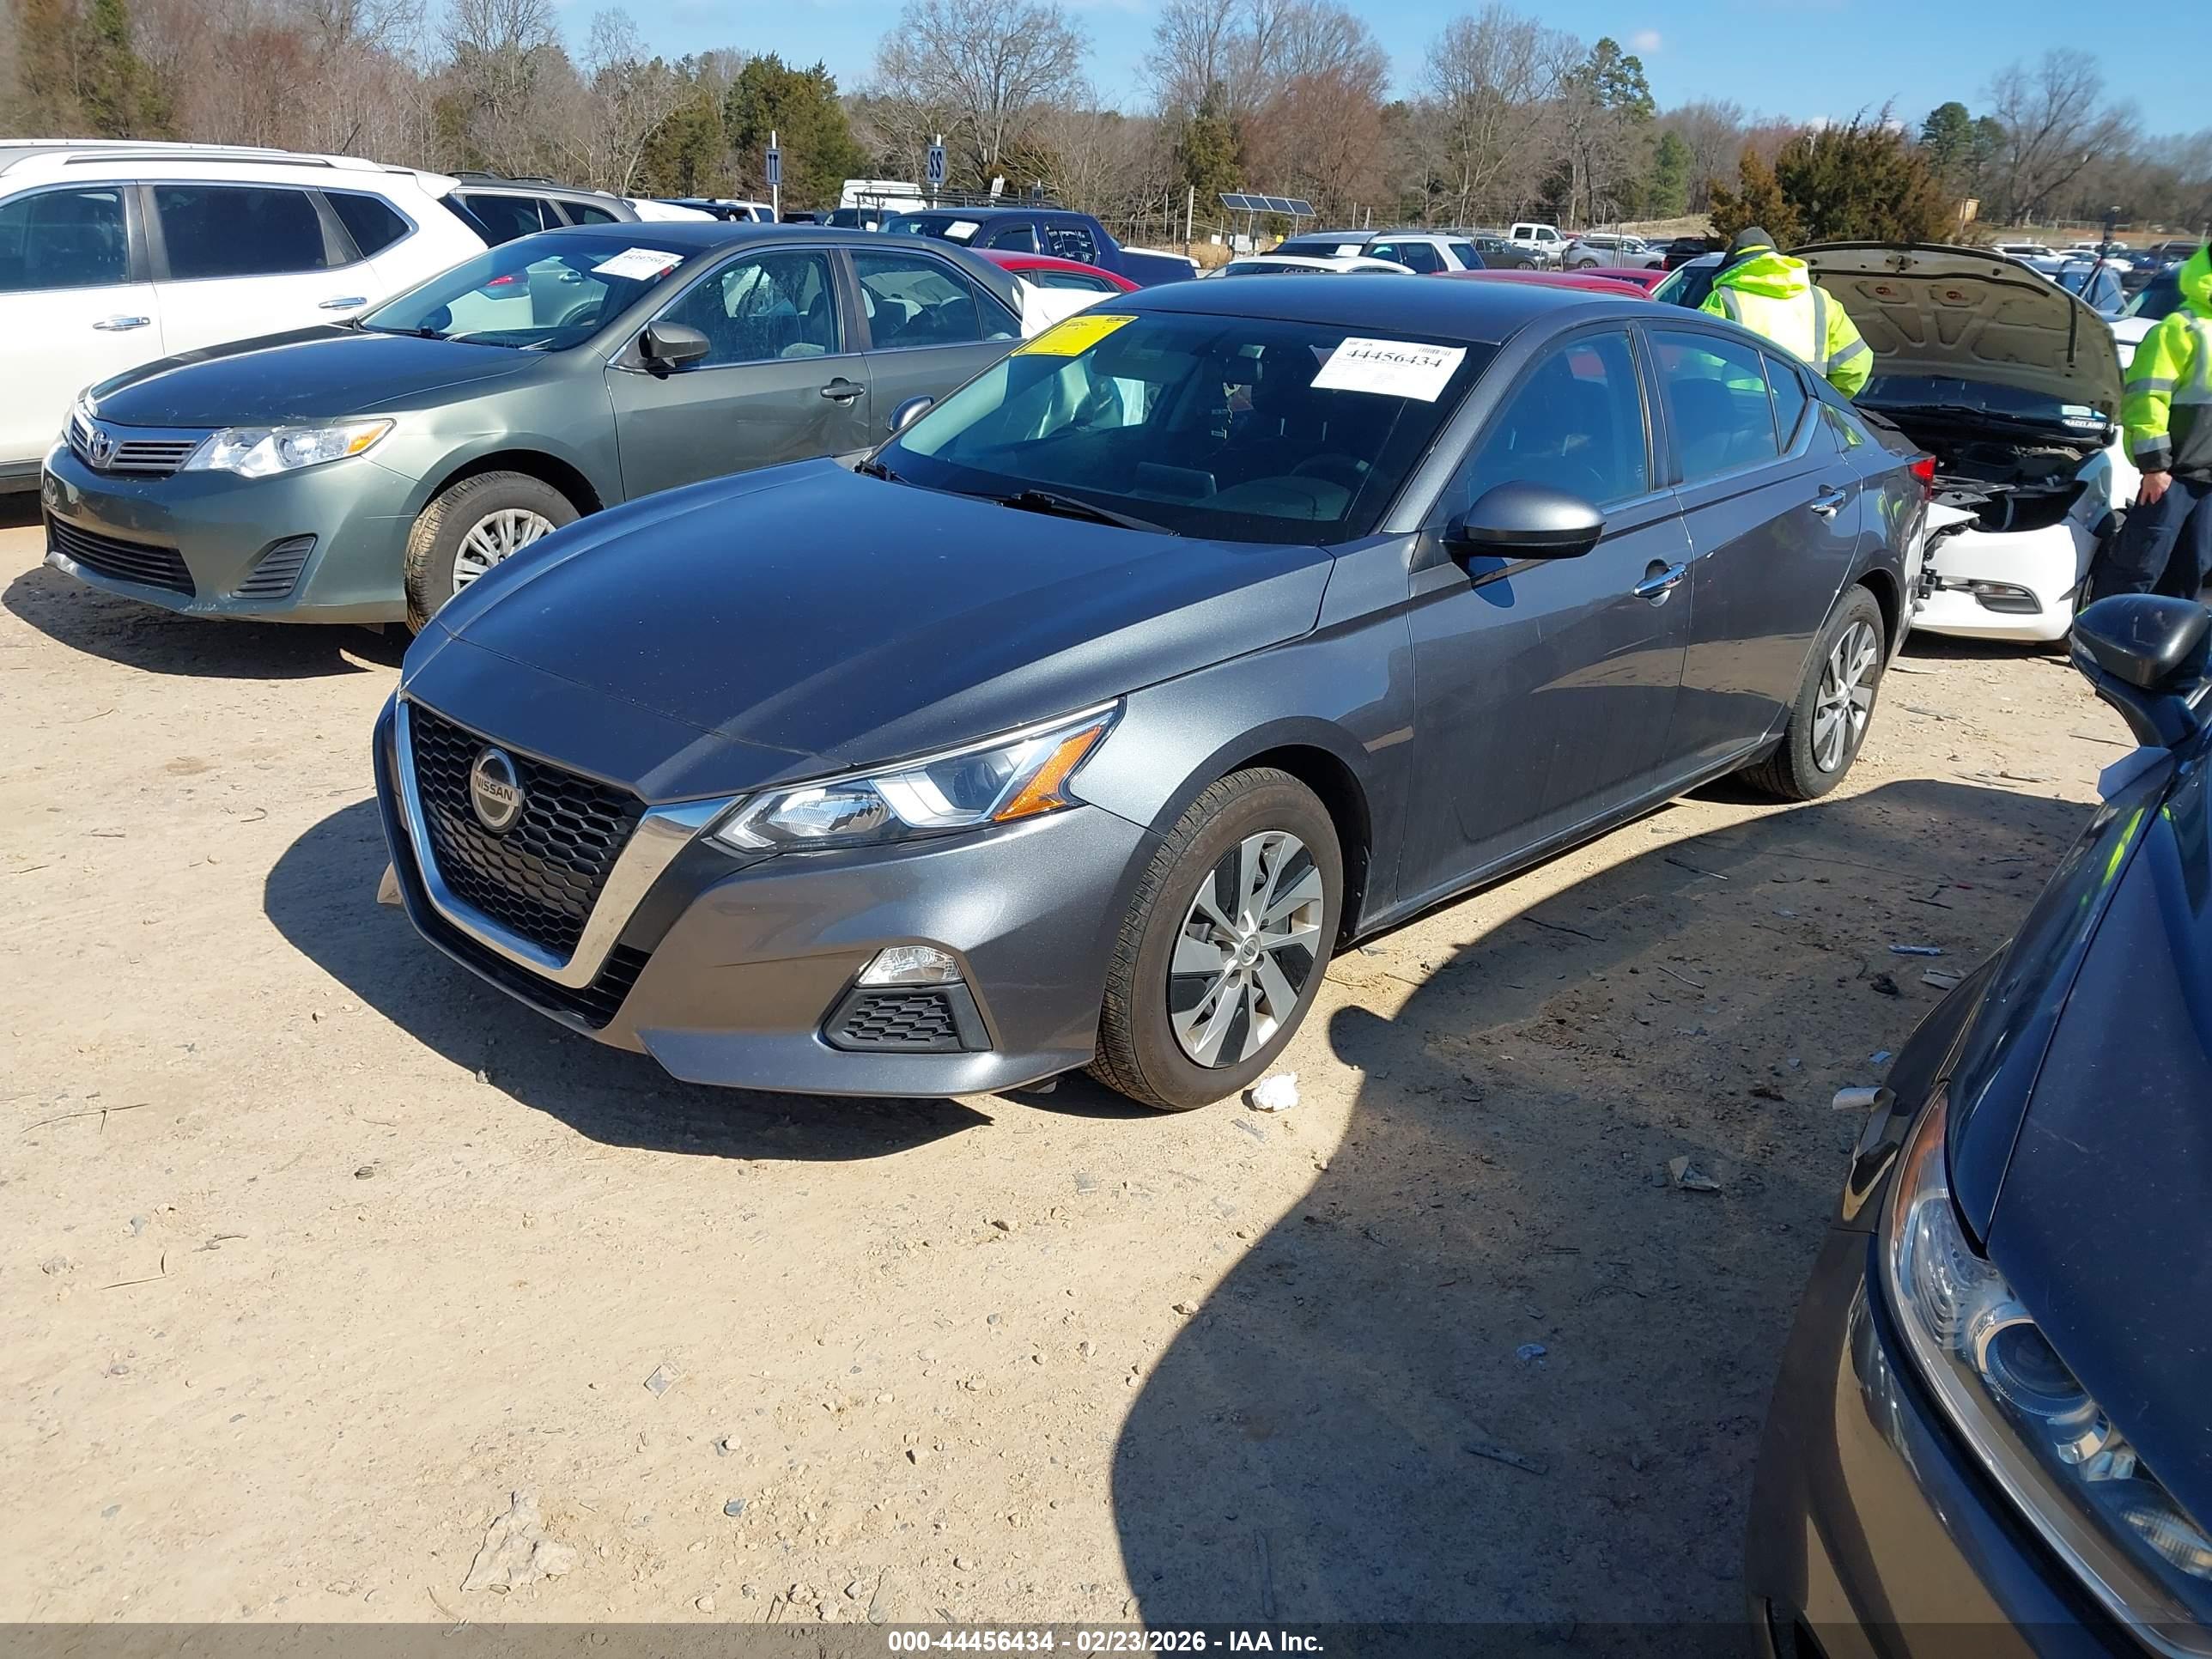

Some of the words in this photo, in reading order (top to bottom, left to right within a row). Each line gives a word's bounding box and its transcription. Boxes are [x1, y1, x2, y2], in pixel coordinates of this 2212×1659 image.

[768, 154, 779, 180] TT
[929, 150, 943, 179] SS
[1346, 349, 1443, 368] 44456434
[474, 775, 514, 801] NISSAN
